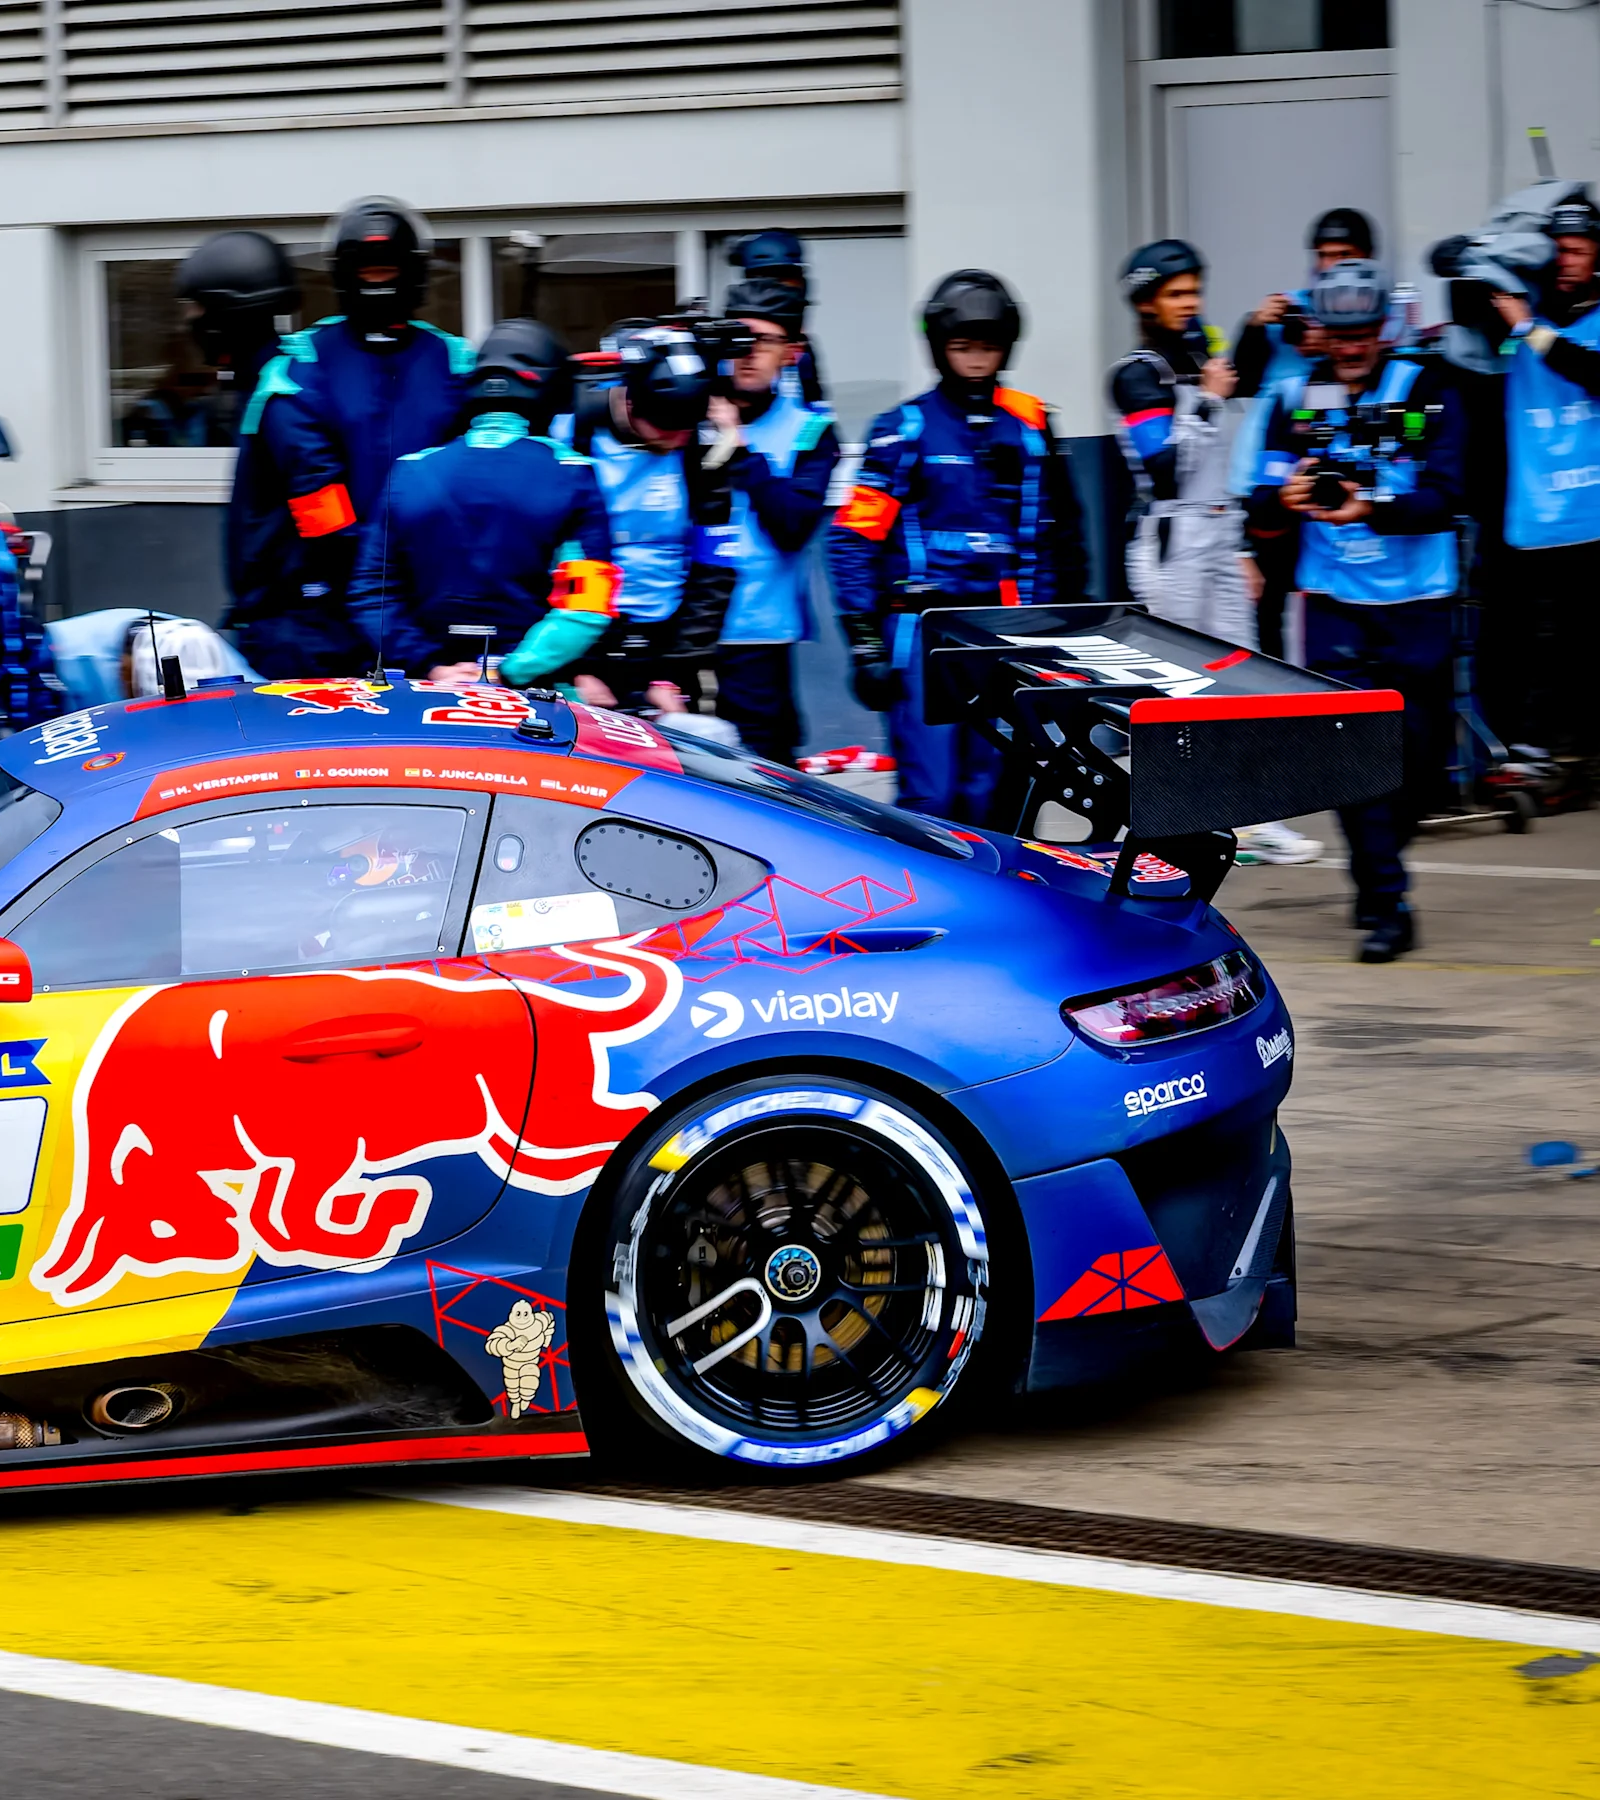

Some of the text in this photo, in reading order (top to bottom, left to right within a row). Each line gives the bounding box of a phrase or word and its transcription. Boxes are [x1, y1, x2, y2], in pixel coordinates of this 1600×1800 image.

[313, 767, 389, 778] J. GOUNON
[422, 768, 528, 786] D. JUNCADELLA
[176, 771, 279, 796] M. VERSTAPPEN
[555, 780, 608, 798] L. AUER
[751, 987, 899, 1025] viaplay
[1124, 1074, 1206, 1115] sparco
